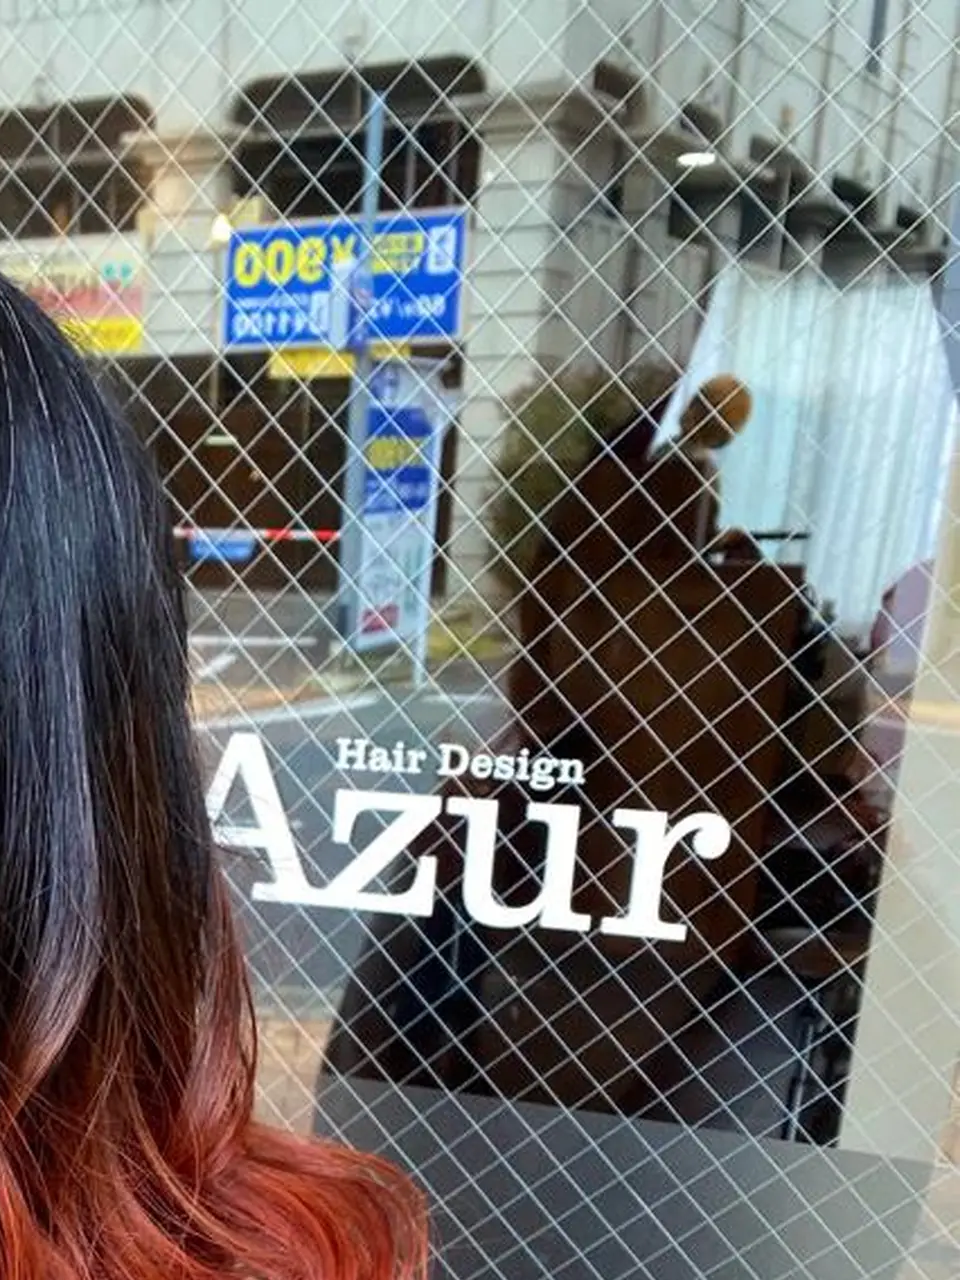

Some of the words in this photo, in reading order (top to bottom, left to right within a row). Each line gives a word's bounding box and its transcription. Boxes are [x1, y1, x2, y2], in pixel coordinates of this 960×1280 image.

[335, 737, 427, 774] Hair
[437, 742, 586, 793] Design
[205, 732, 732, 942] Azur
